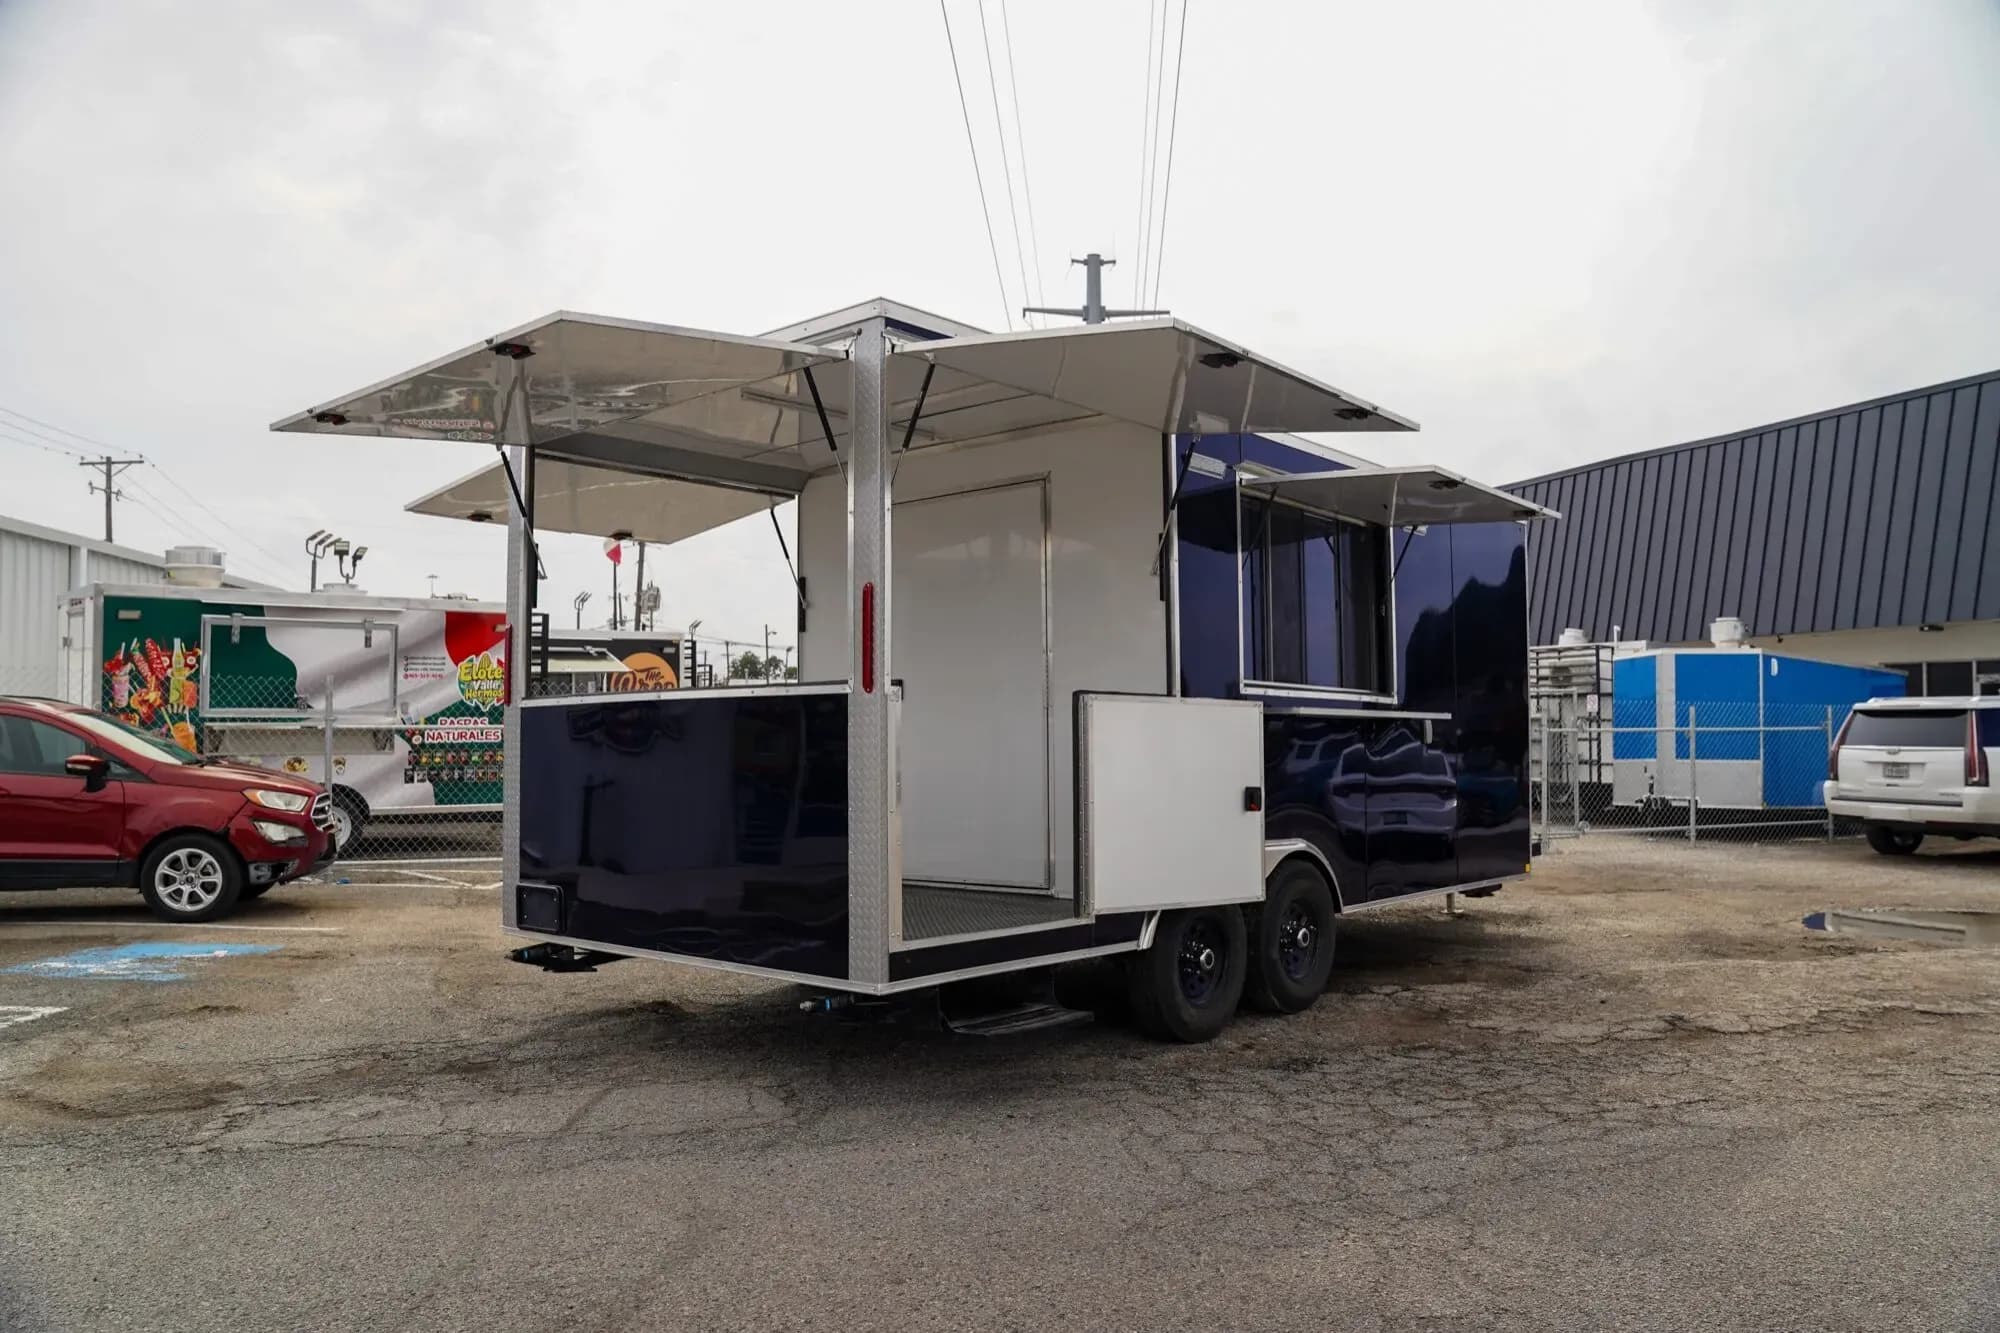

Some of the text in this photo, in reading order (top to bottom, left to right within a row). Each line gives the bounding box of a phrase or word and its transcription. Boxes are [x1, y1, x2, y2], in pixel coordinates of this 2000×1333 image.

[460, 663, 504, 681] Elote
[465, 687, 504, 700] Hermos
[426, 730, 500, 742] NATURALES
